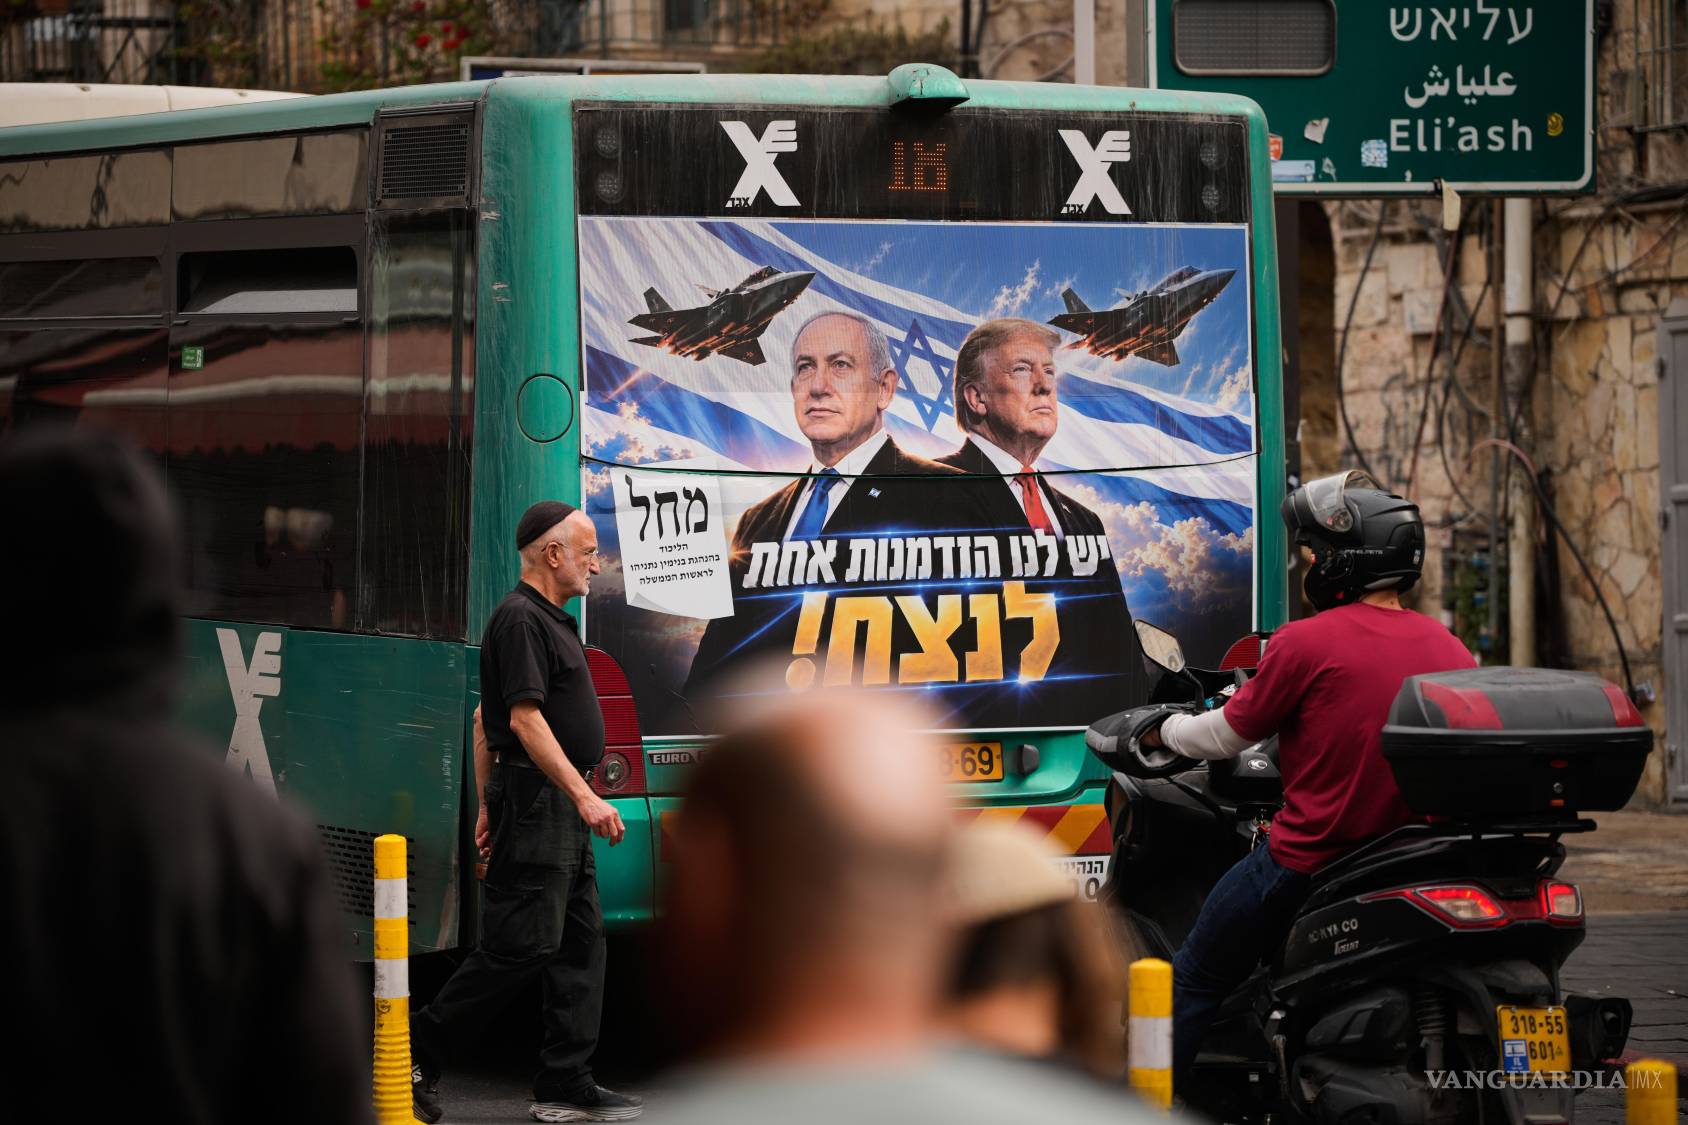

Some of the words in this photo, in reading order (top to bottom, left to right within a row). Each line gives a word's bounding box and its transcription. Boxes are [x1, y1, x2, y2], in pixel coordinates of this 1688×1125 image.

[1390, 0, 1533, 45] עליאש
[1404, 64, 1517, 109] علياش
[1390, 116, 1533, 152] Eli'ash
[625, 474, 708, 542] מחל
[659, 542, 688, 553] הליכוד
[688, 554, 720, 565] בהנהגת
[845, 535, 999, 582] הזדמנות
[1009, 528, 1059, 577] לנו
[1064, 534, 1111, 577] יש
[630, 561, 658, 571] נתניהו
[659, 558, 686, 571] בנימין
[680, 568, 714, 580] לראשות
[742, 539, 838, 589] אחת
[639, 574, 678, 585] הממשלה
[785, 580, 1061, 694] לנצח!
[653, 753, 690, 764] EURO
[1511, 1015, 1564, 1035] 318-55
[1528, 1041, 1555, 1061] 601
